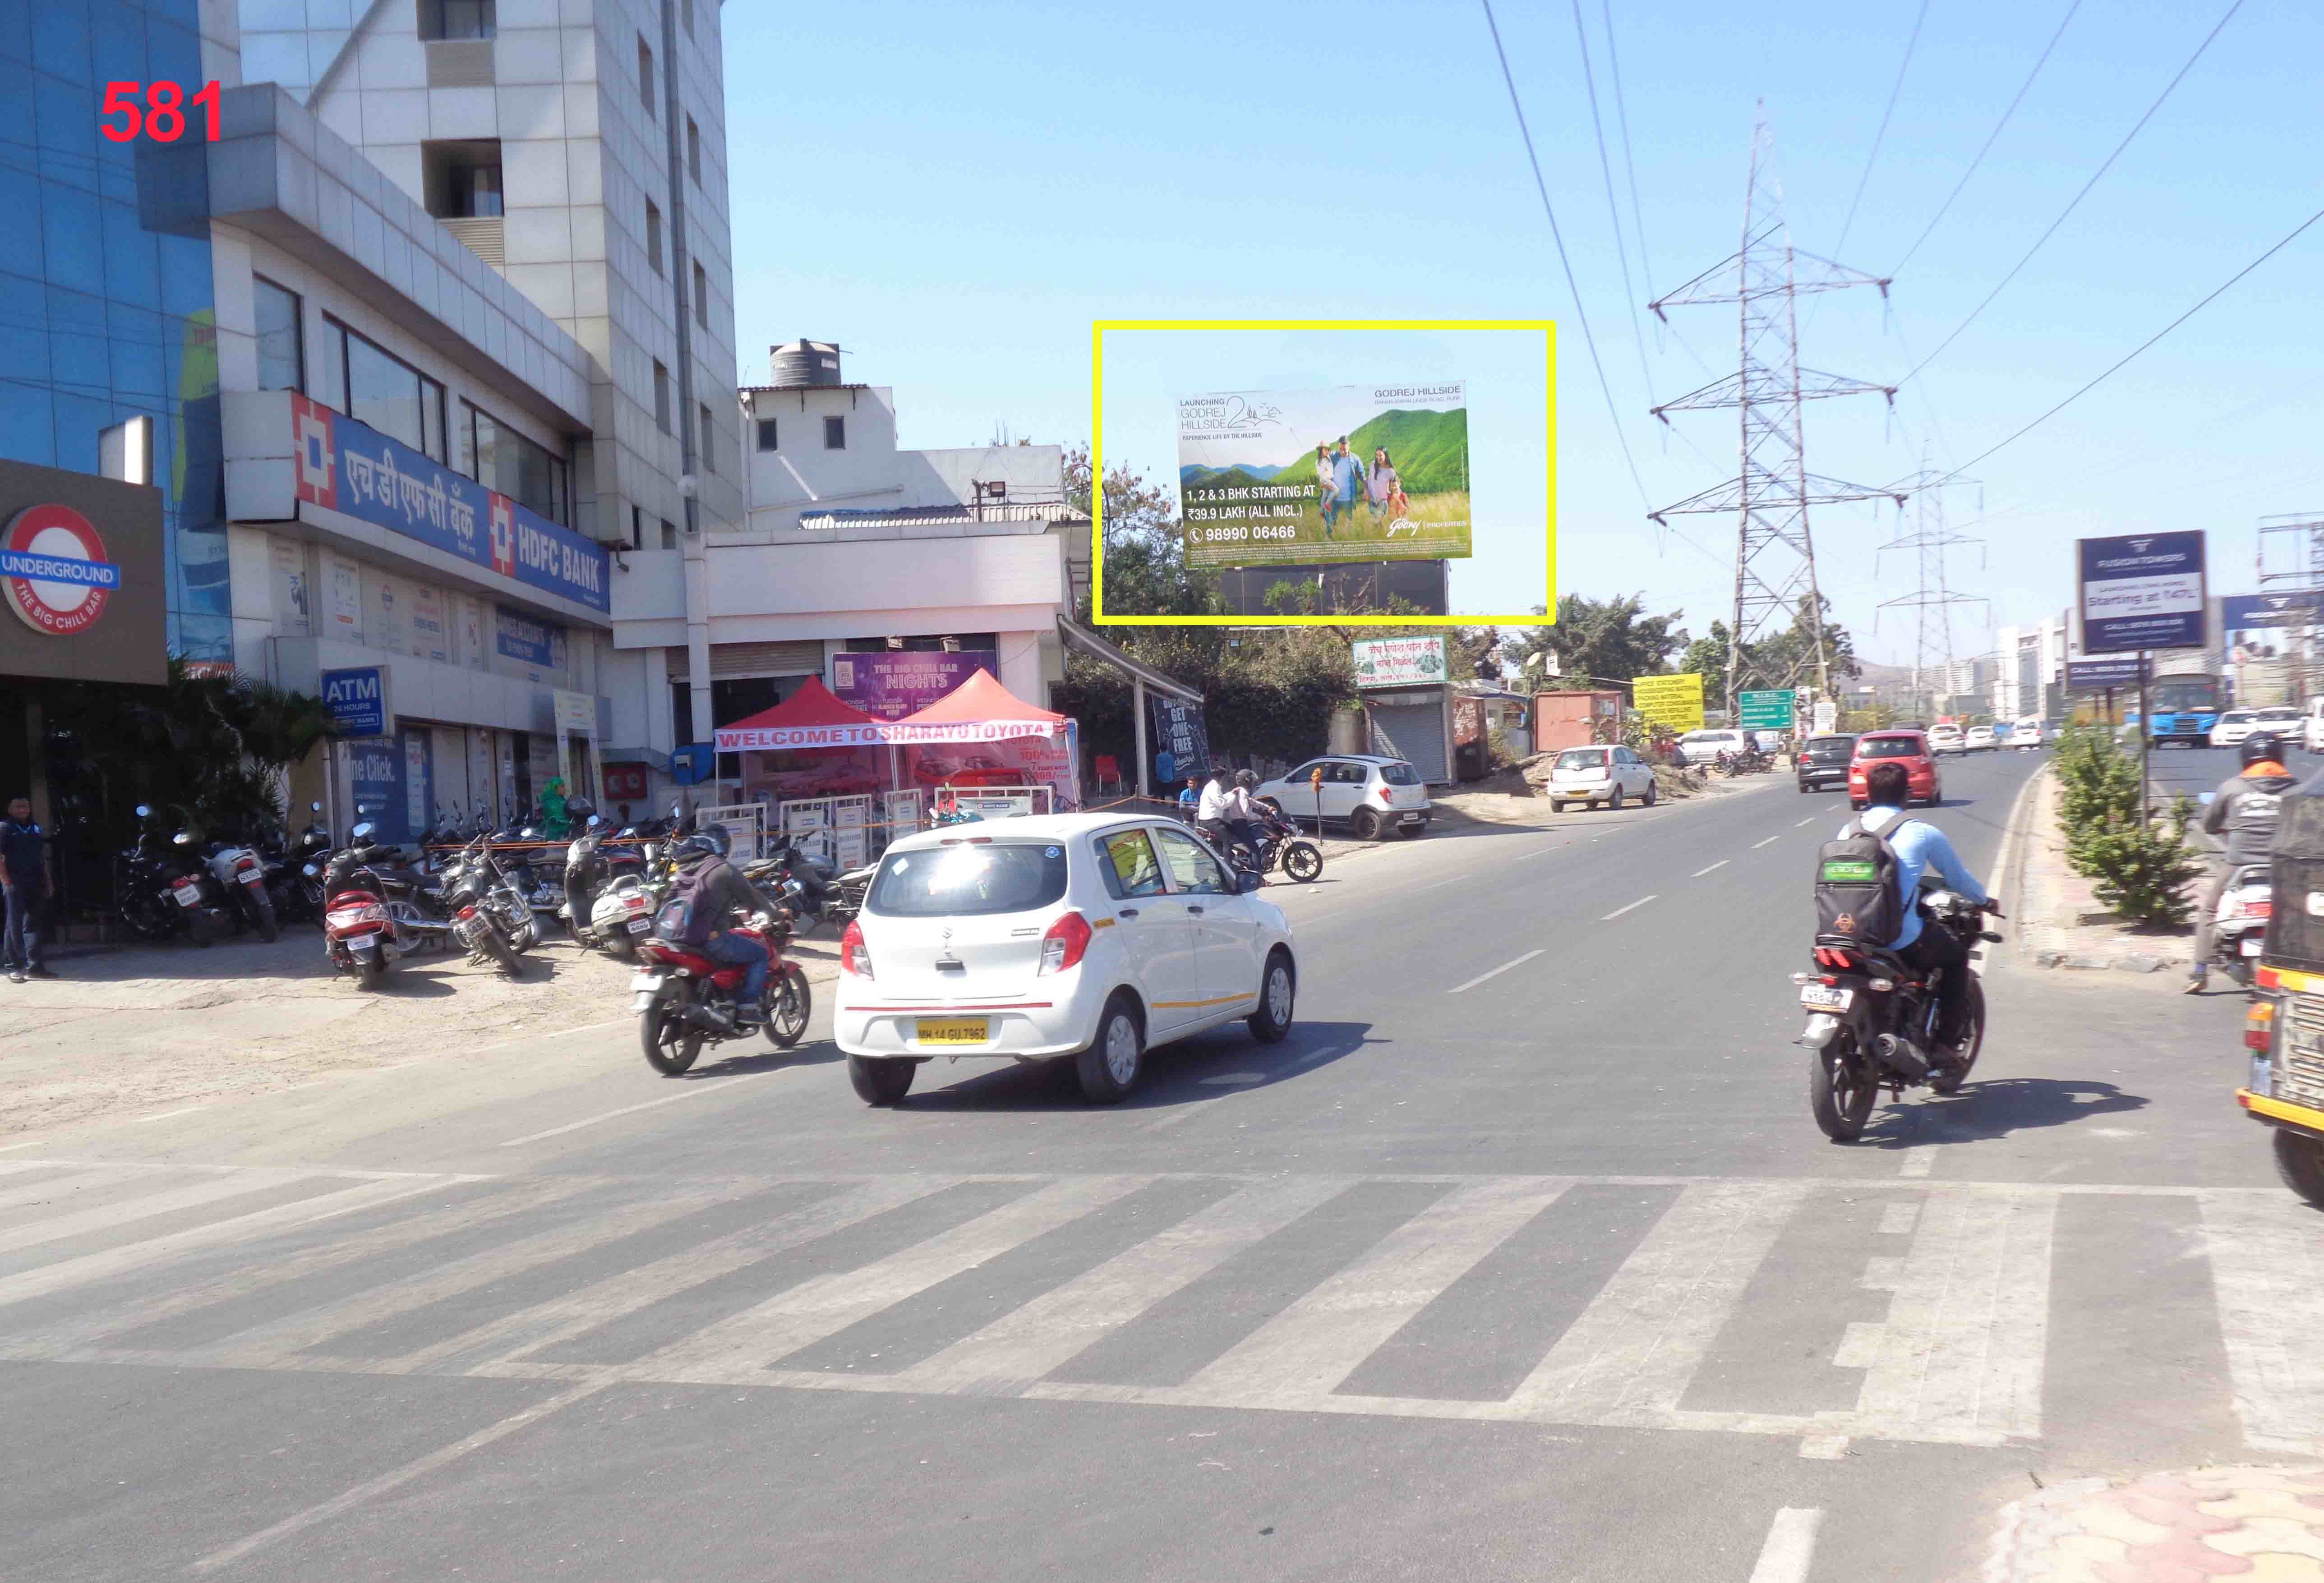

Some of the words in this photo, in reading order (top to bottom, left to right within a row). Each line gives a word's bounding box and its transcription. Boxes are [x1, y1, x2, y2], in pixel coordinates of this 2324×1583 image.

[1374, 388, 1415, 397] GODREJ
[1418, 386, 1461, 396] HILLSIDE
[1180, 398, 1225, 406] LAUNCHING
[1180, 408, 1226, 419] GODREJ
[1181, 419, 1226, 430] HILLSIDE
[1187, 490, 1196, 502] 1,
[1199, 490, 1205, 501] 2
[1208, 489, 1216, 501] &
[1218, 489, 1225, 500] 3
[1228, 488, 1249, 499] BHK
[1252, 486, 1300, 498] STARTING
[1303, 485, 1315, 497] AT
[1219, 506, 1245, 519] LAKH
[1249, 505, 1271, 519] (ALL
[1273, 504, 1303, 518] INCL.)
[1205, 527, 1248, 541] 98990
[1253, 525, 1296, 539] 06466
[518, 524, 559, 577] HDFC
[563, 543, 599, 594] BANK
[1, 555, 113, 583] UNDERGROUND
[18, 583, 34, 607] THE
[33, 607, 53, 625] BIG
[56, 612, 87, 628] CHILL
[85, 592, 101, 615] BAR
[2087, 594, 2143, 607] Starting
[2146, 592, 2160, 602] at
[874, 665, 892, 673] THE
[894, 664, 911, 673] BIG
[913, 664, 937, 673] CHILL
[940, 663, 958, 672] BAR
[886, 673, 948, 689] NIGHTS
[327, 677, 377, 702] ATM
[343, 702, 371, 711] HOURS
[1171, 707, 1186, 722] GET
[718, 729, 843, 748] WELCOME
[846, 727, 877, 742] TO
[881, 725, 968, 741] SHARAYU
[971, 723, 1044, 738] TOYOTA
[1173, 722, 1189, 737] ONE
[1173, 737, 1192, 752] FREE
[366, 754, 396, 782] Click.
